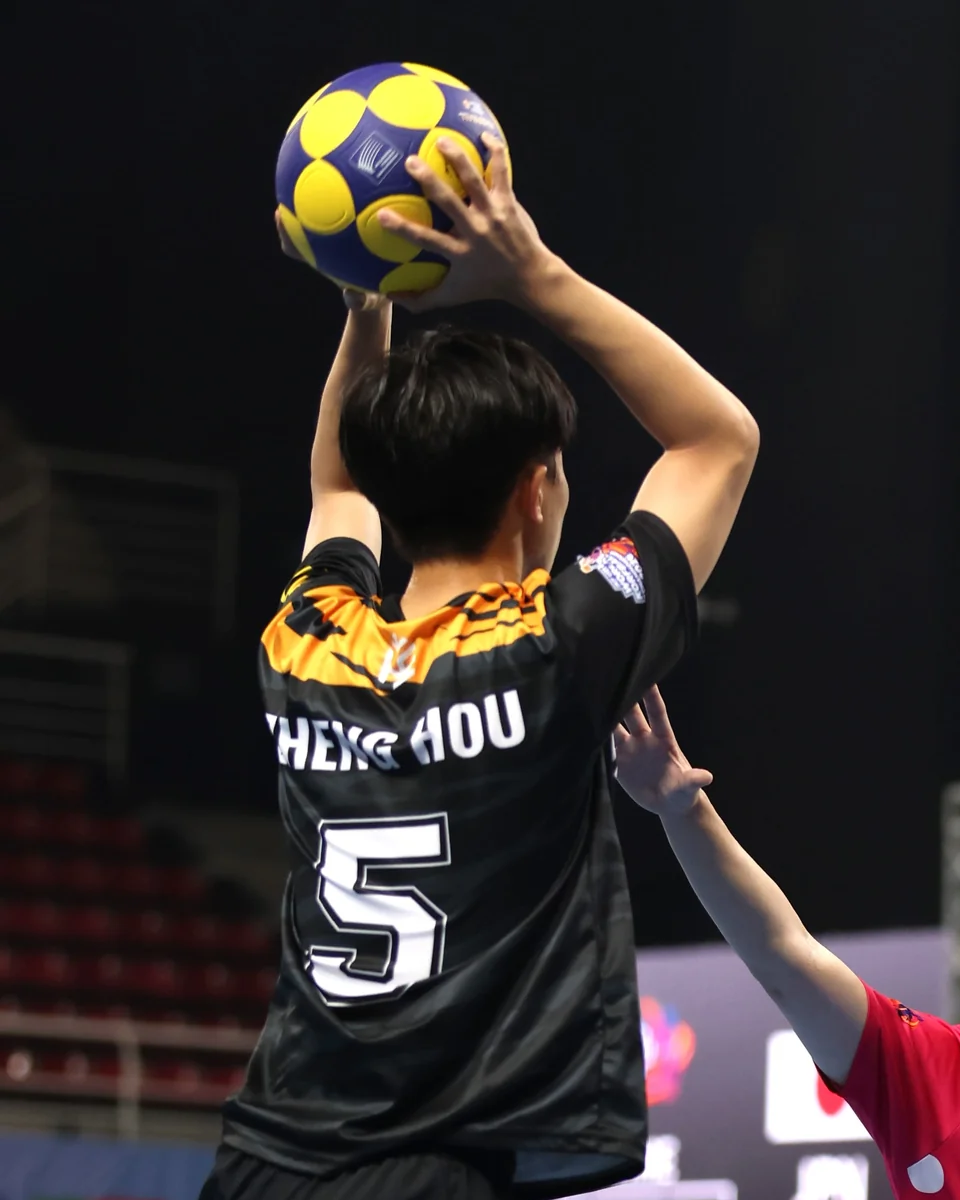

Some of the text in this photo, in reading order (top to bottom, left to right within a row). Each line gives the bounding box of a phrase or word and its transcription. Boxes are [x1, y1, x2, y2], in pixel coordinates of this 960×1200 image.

[265, 689, 526, 772] HENG HOU
[304, 811, 451, 1007] 5
